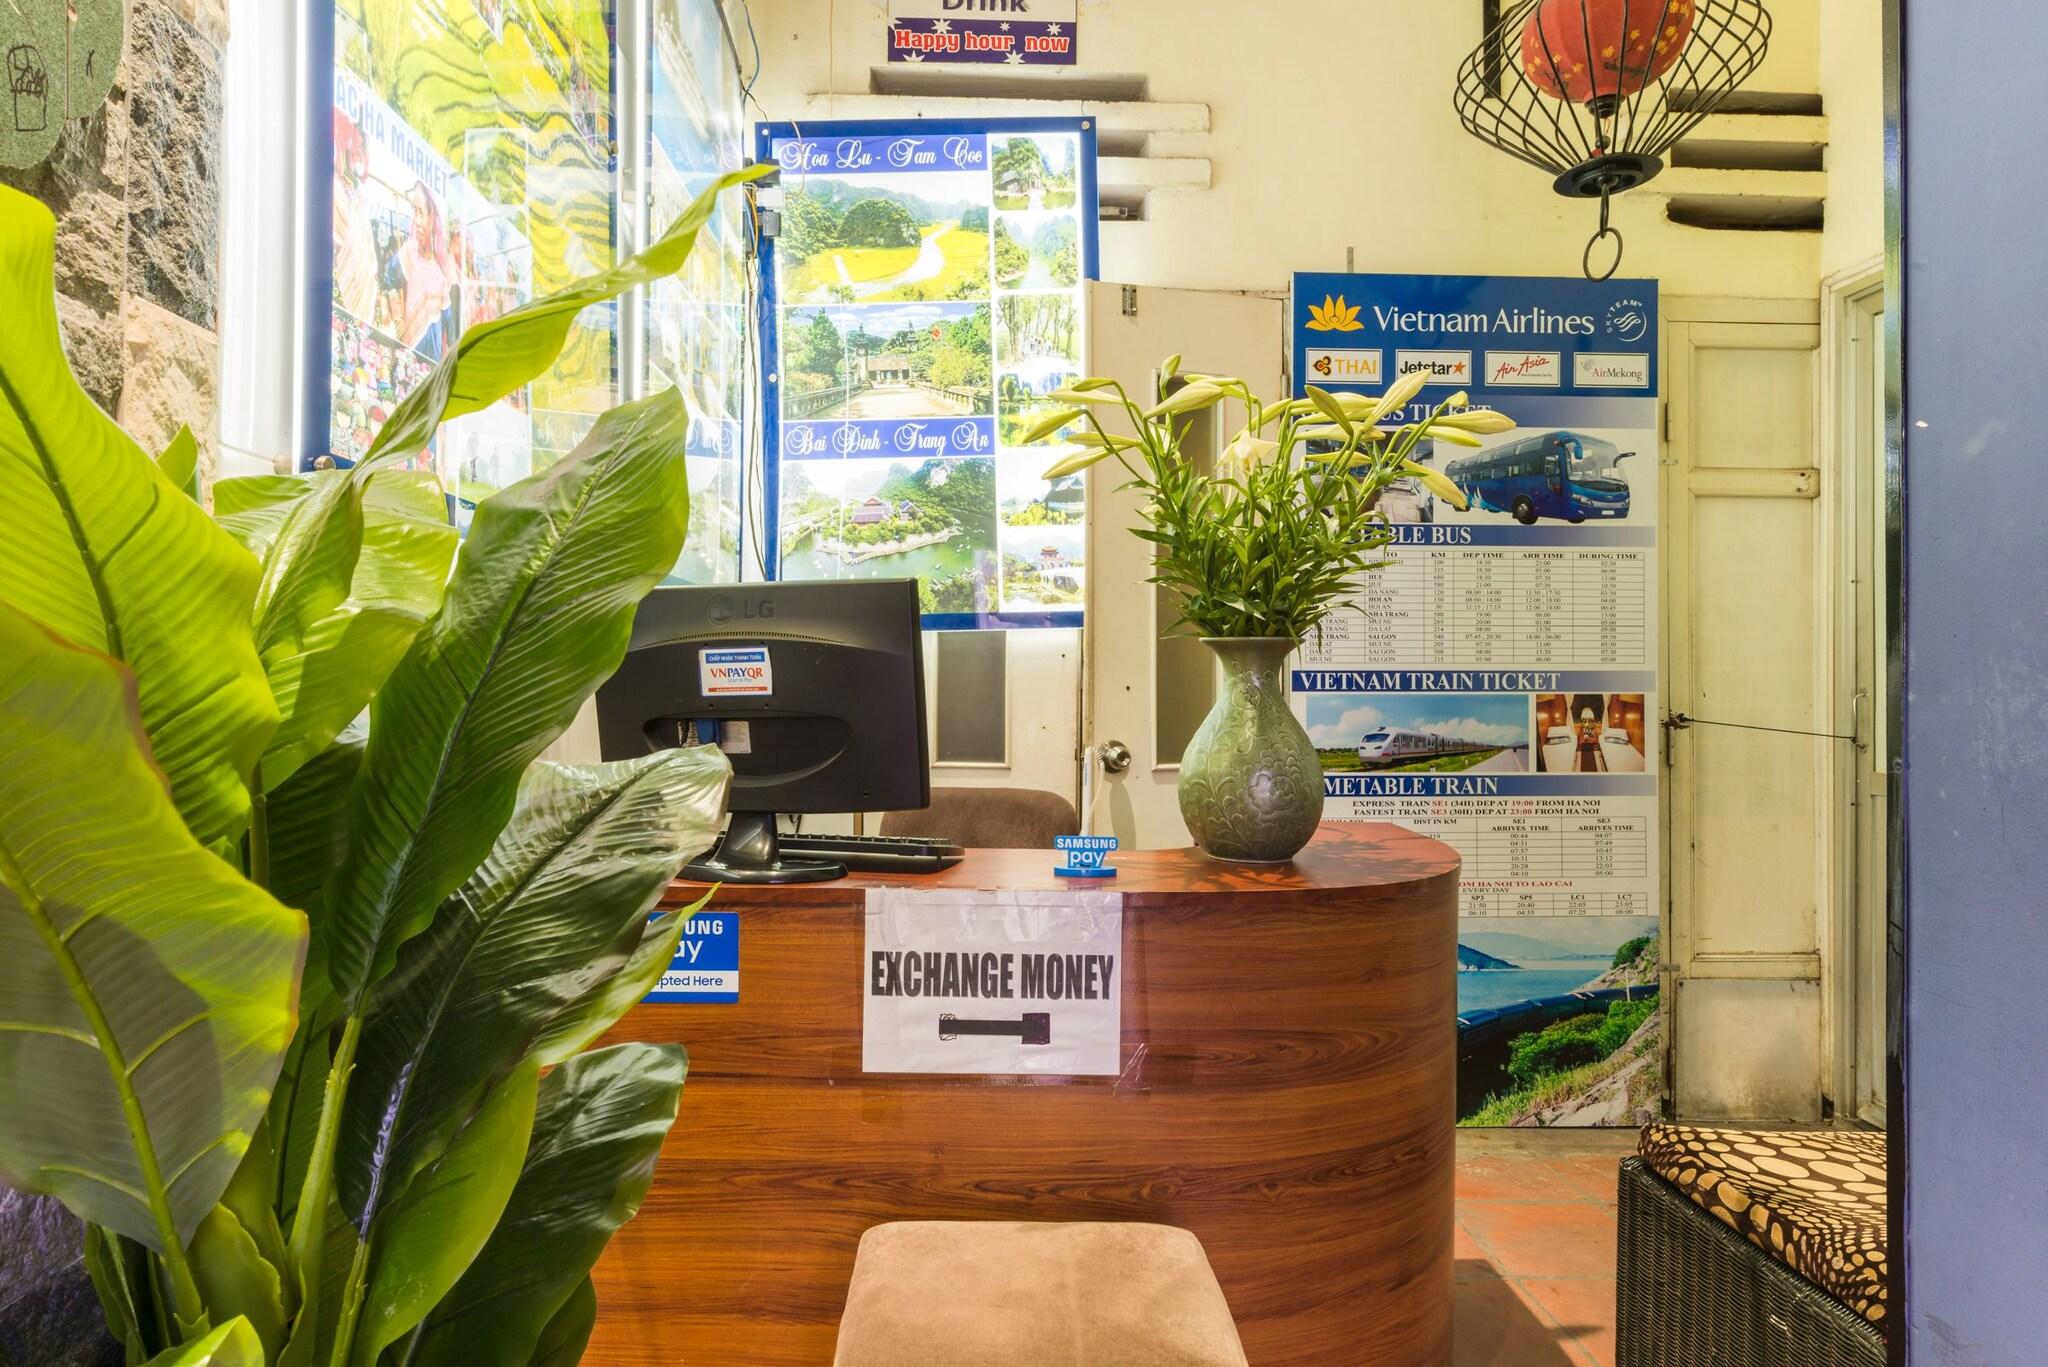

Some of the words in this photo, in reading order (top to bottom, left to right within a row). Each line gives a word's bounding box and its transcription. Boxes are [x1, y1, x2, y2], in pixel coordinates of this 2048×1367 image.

[895, 29, 959, 52] Happy
[965, 31, 1014, 51] hour
[1025, 35, 1069, 53] now
[391, 124, 448, 199] MARKET
[836, 140, 872, 169] Lu
[1374, 305, 1488, 332] Vietnam
[1493, 307, 1594, 335] Airlines
[1336, 360, 1376, 374] THAI
[1400, 360, 1452, 376] Jetstar
[1493, 362, 1518, 382] Air
[1517, 355, 1550, 376] Asia
[1592, 368, 1642, 383] AirMekong
[786, 424, 826, 455] Bai
[894, 422, 946, 456] Trang
[1431, 527, 1471, 545] BUS
[744, 600, 776, 619] LG
[710, 667, 763, 679] VNPAYQR
[1300, 672, 1400, 690] VIETNAM
[1406, 672, 1473, 690] TRAIN
[1479, 672, 1560, 690] TICKET
[1324, 778, 1426, 795] METABLE
[1431, 778, 1498, 795] TRAIN
[1057, 838, 1116, 848] SAMSUNG
[1070, 851, 1104, 867] pay
[674, 940, 703, 963] ay
[656, 976, 690, 988] epted
[693, 976, 723, 985] Here
[871, 951, 1014, 999] EXCHANGE
[1021, 954, 1113, 1000] MONEY
